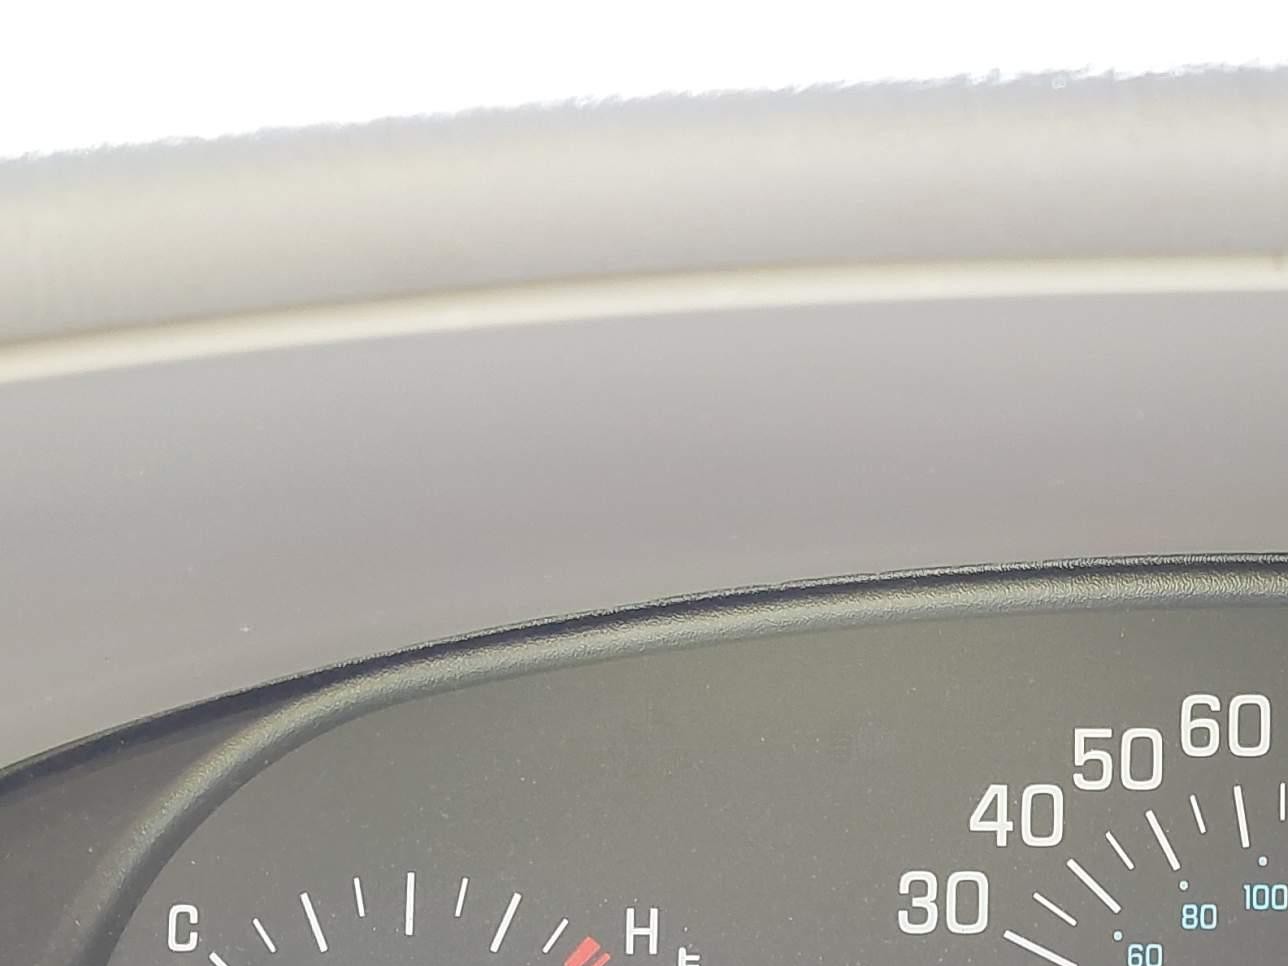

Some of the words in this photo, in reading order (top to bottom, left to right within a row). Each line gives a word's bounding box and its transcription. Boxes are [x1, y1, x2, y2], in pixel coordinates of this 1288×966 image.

[1180, 694, 1271, 757] 60
[1072, 727, 1163, 791] 50
[969, 784, 1064, 847] 40
[898, 870, 989, 934] 30
[1181, 903, 1217, 930] 80
[1243, 884, 1288, 910] 100
[167, 904, 198, 952] C
[625, 907, 659, 955] H
